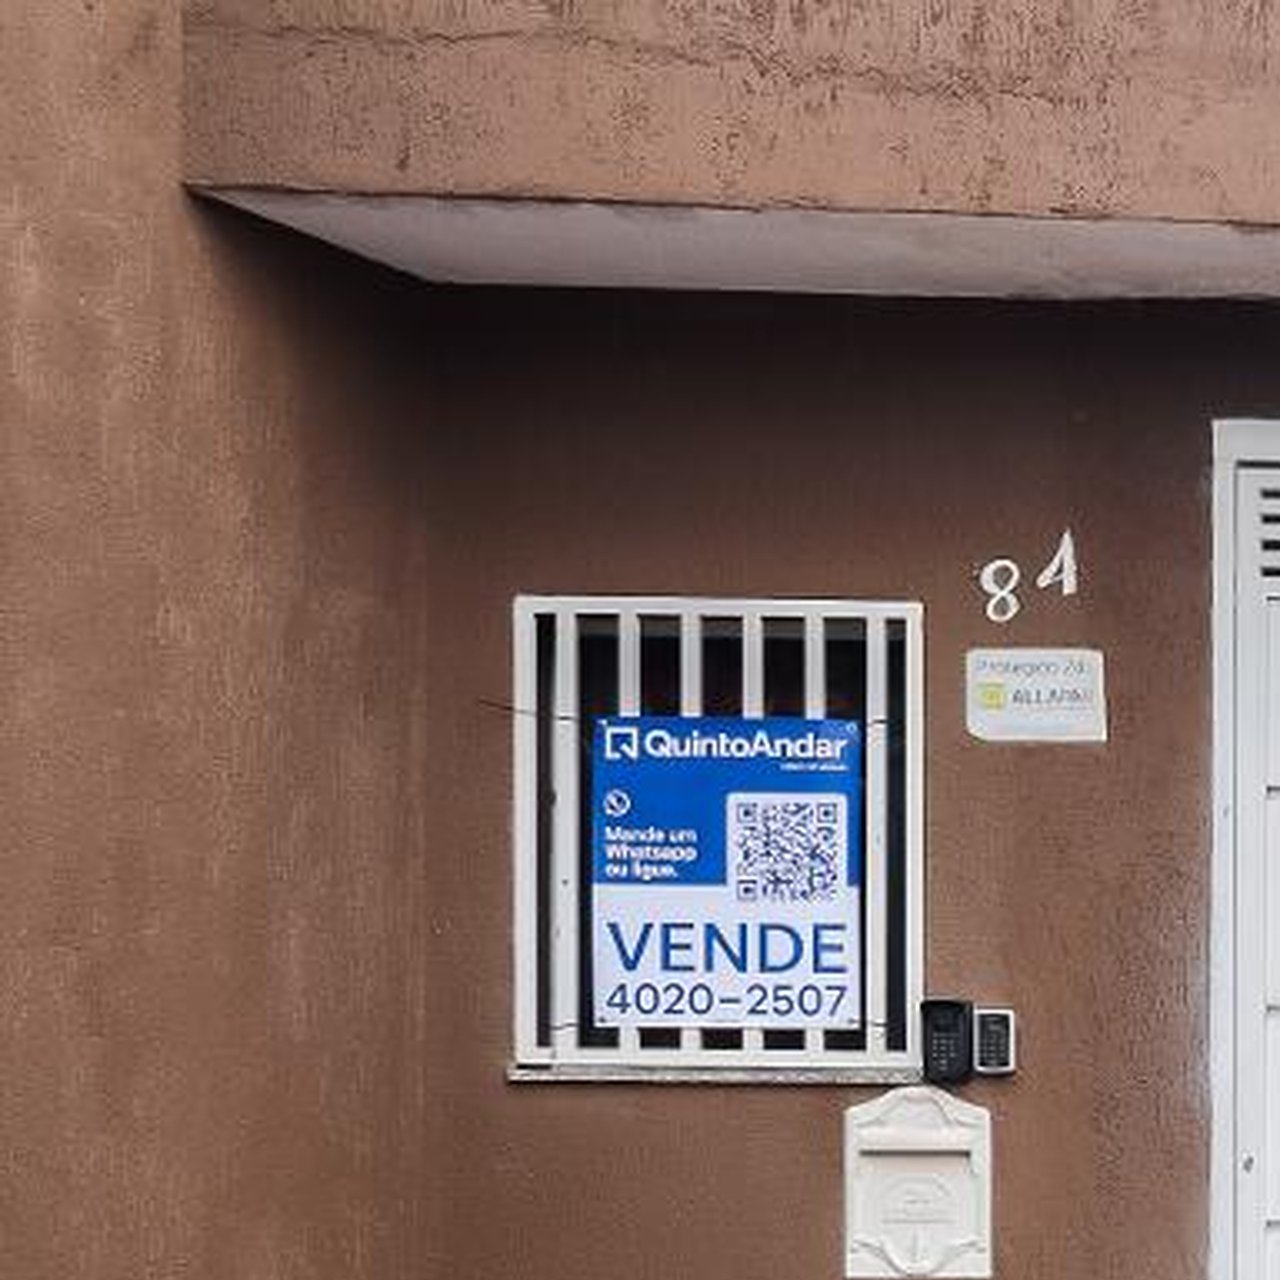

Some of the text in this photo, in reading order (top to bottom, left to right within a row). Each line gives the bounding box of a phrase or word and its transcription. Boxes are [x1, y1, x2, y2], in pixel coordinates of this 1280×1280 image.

[644, 728, 848, 758] QuintoAndar
[605, 826, 698, 843] Mande um
[605, 864, 628, 878] ou
[606, 922, 848, 974] VENDE
[606, 982, 848, 1017] 4020-2507
